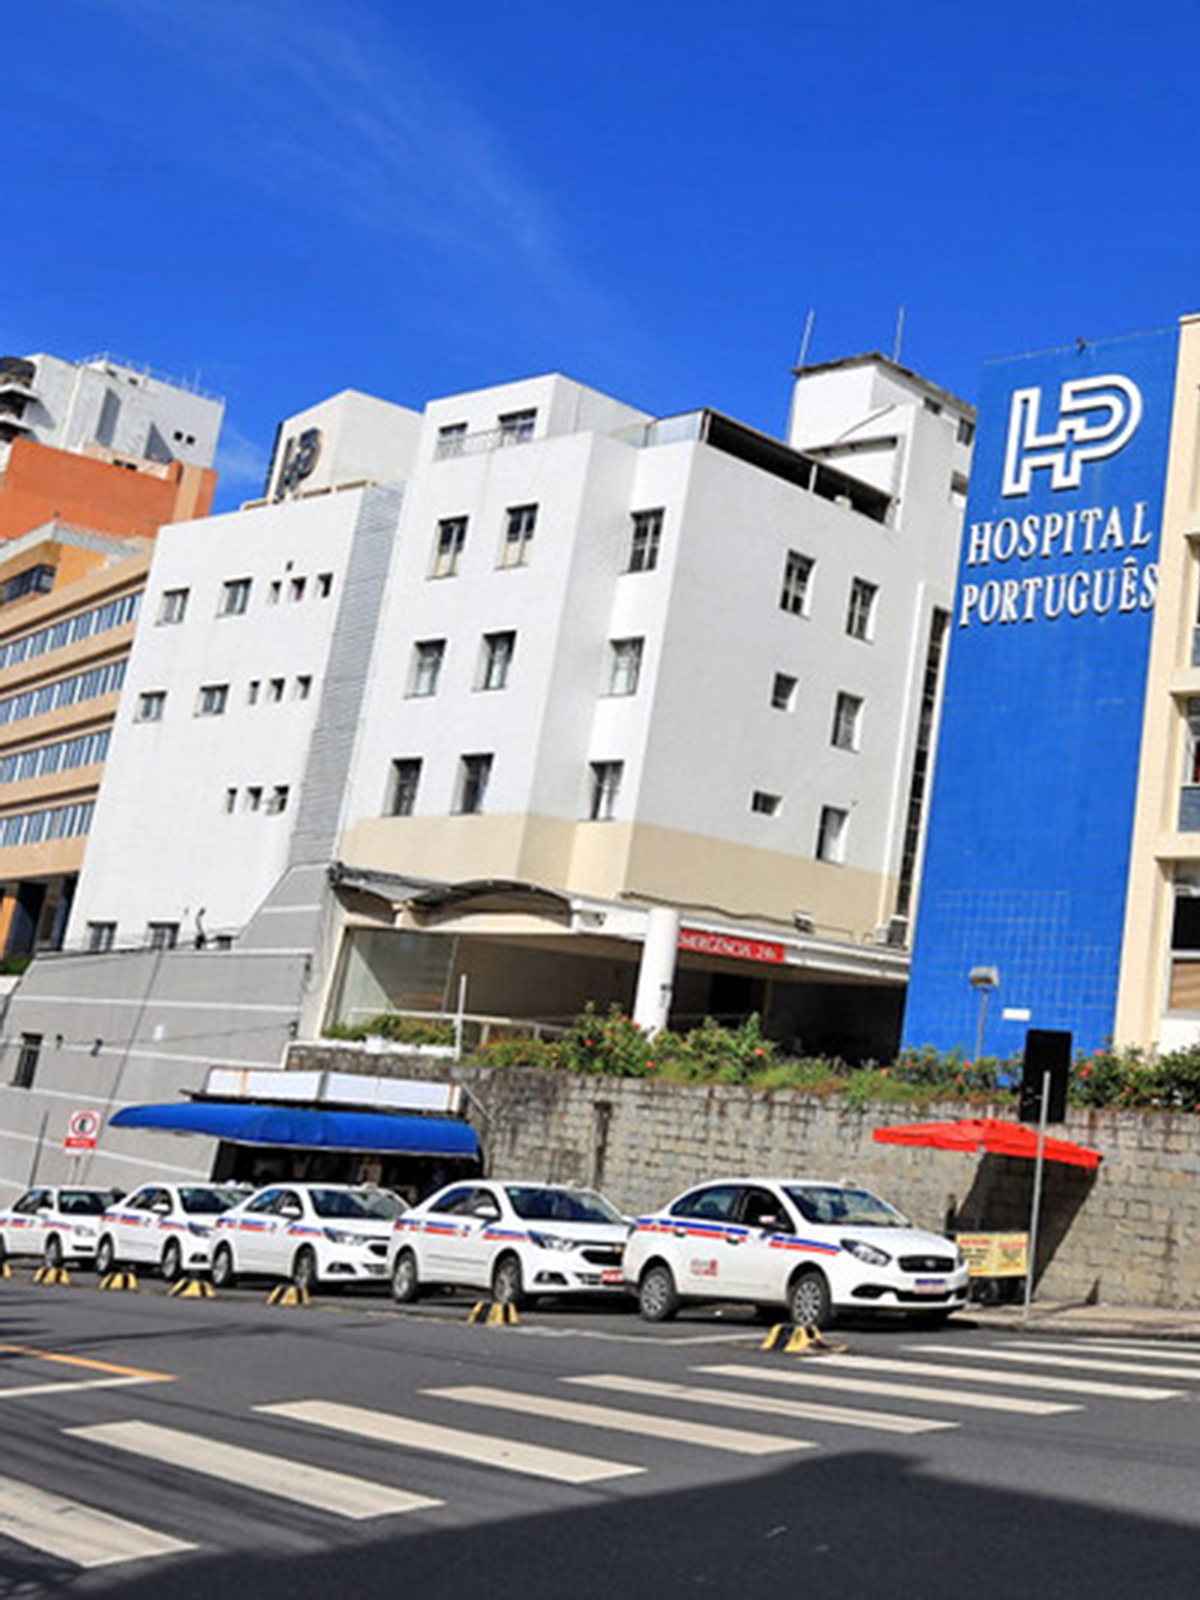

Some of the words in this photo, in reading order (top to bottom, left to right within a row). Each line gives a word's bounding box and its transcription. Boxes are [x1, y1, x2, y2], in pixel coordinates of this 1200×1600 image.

[1002, 374, 1143, 498] HP
[968, 502, 1152, 566] HOSPITAL
[958, 556, 1159, 629] PORTUGUÊS
